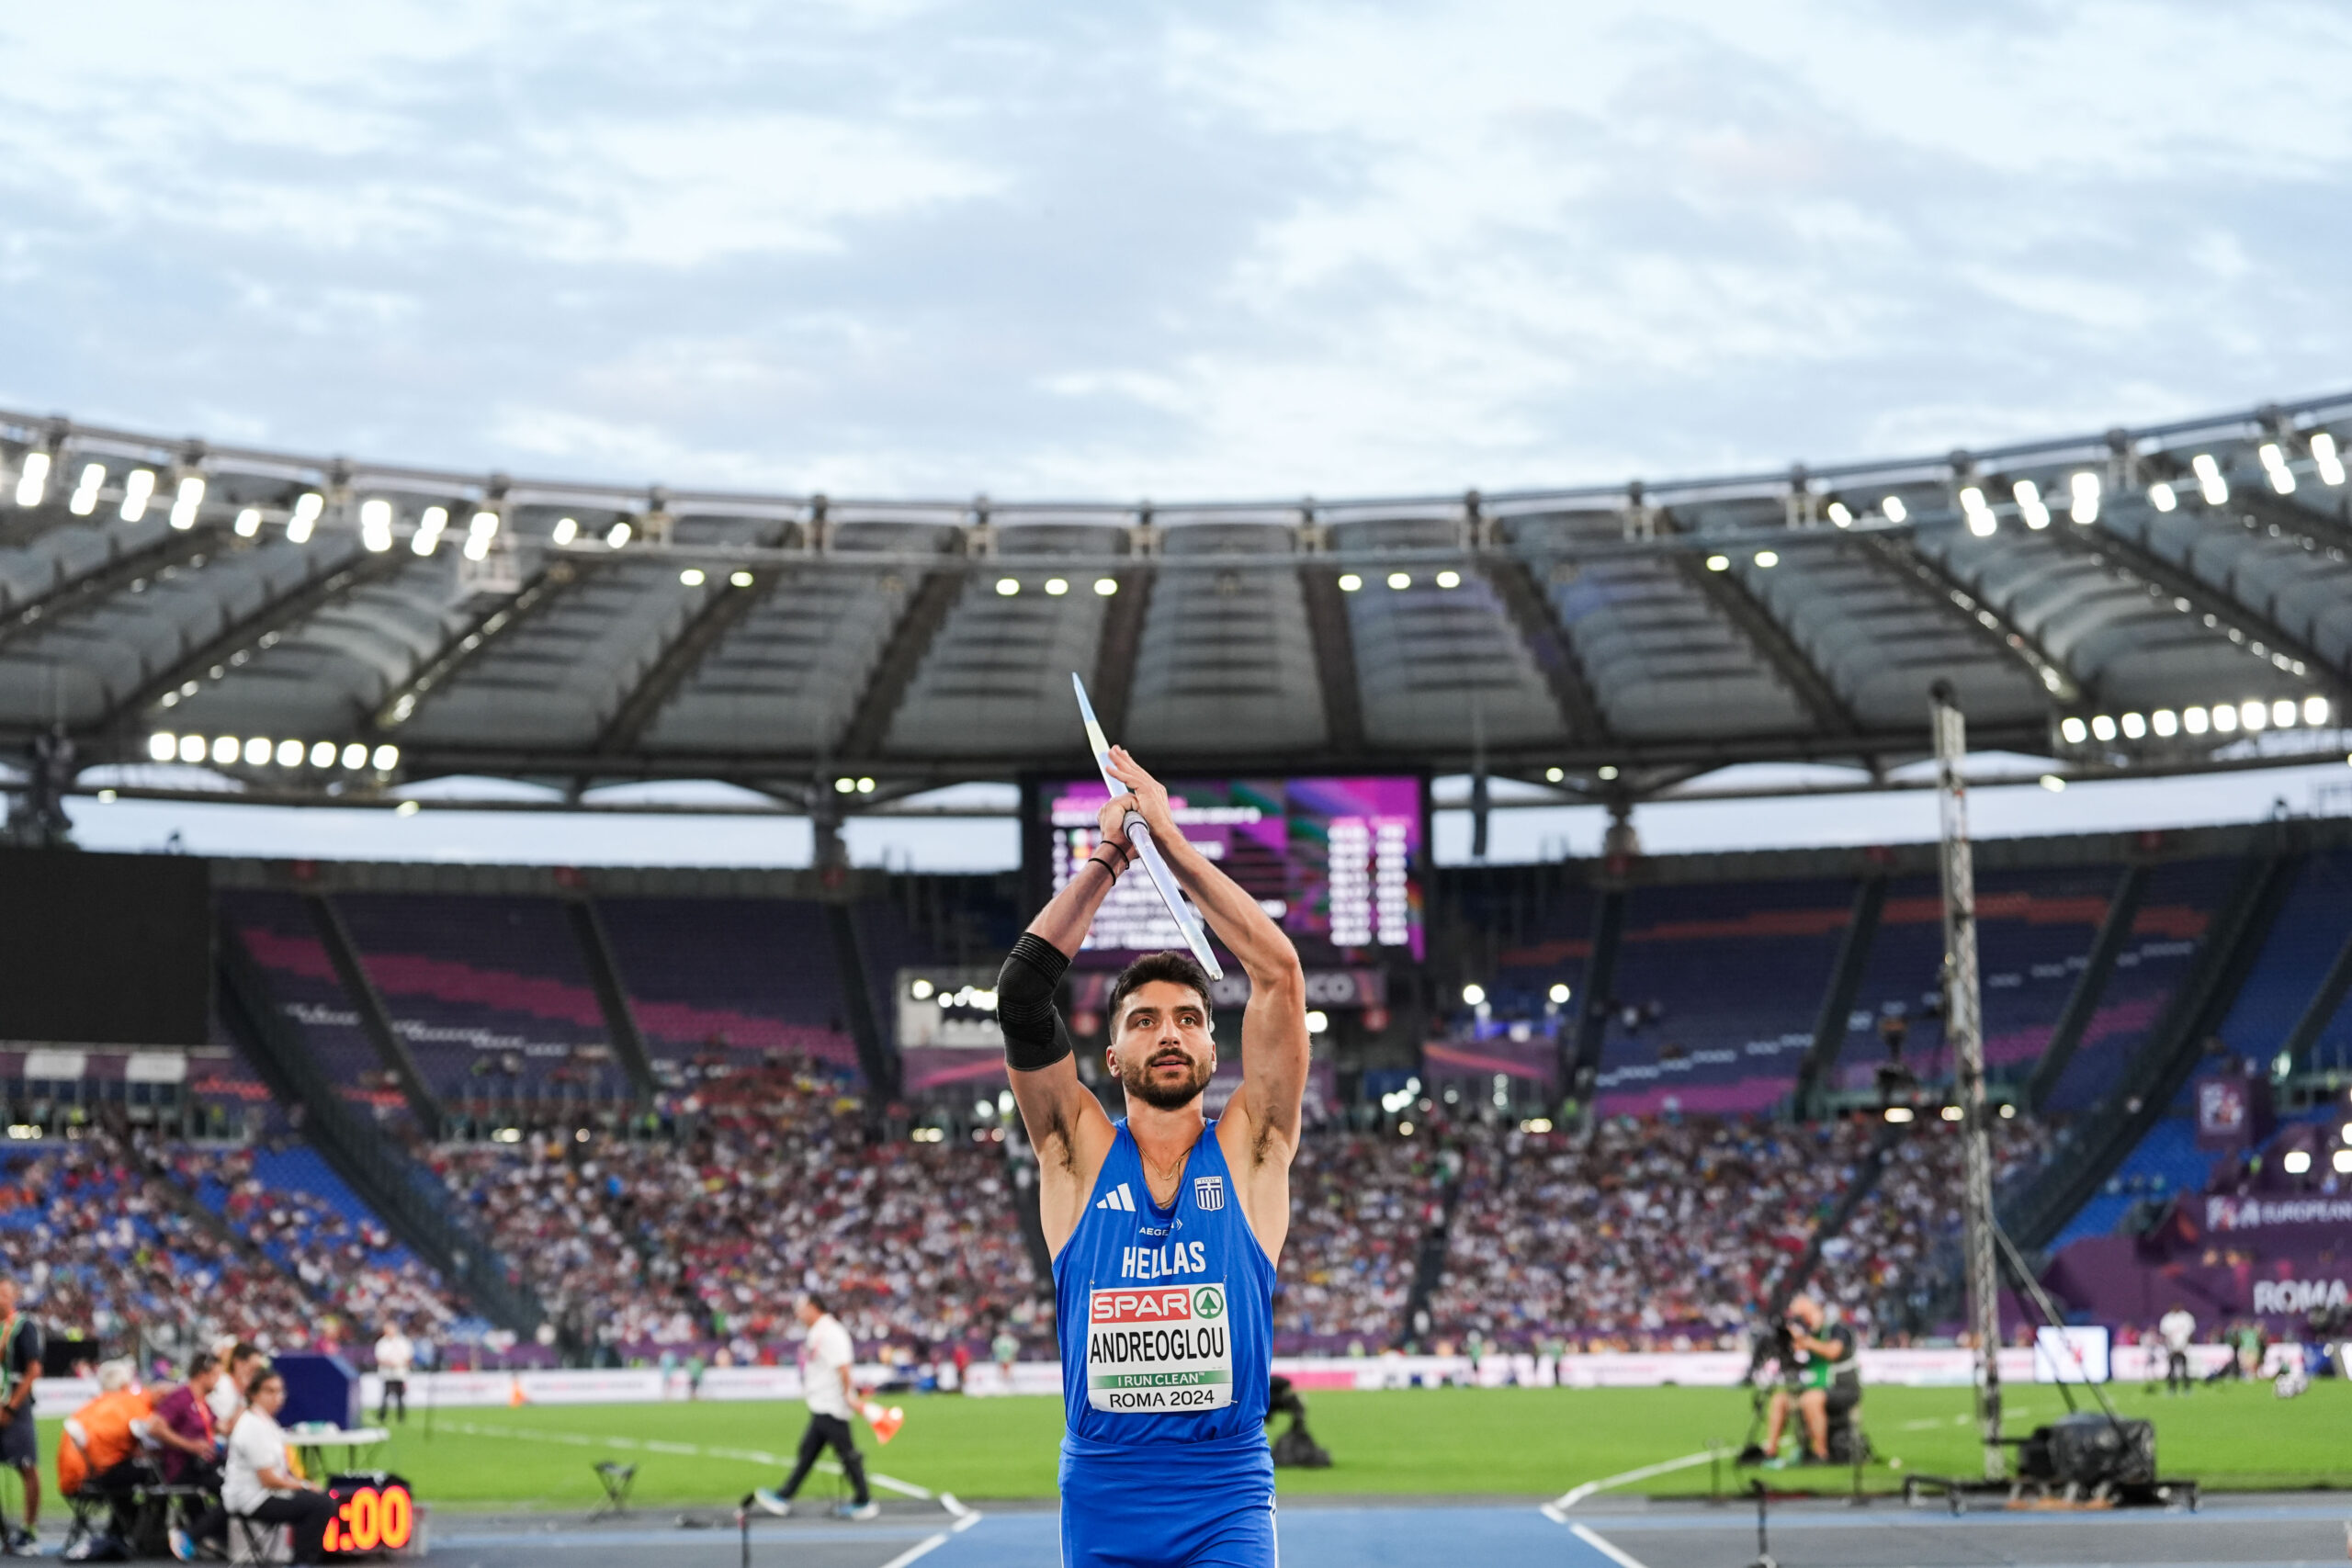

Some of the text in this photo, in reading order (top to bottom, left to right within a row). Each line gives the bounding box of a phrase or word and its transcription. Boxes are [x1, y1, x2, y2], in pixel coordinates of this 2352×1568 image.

[1121, 1241, 1206, 1279] HELLAS
[1093, 1293, 1188, 1319] SPAR
[2253, 1279, 2348, 1314] ROMA
[1090, 1326, 1225, 1364] ANDREOGLOU
[1117, 1376, 1122, 1387] I
[1124, 1375, 1152, 1386] RUN
[1109, 1389, 1215, 1408] ROMA 2024
